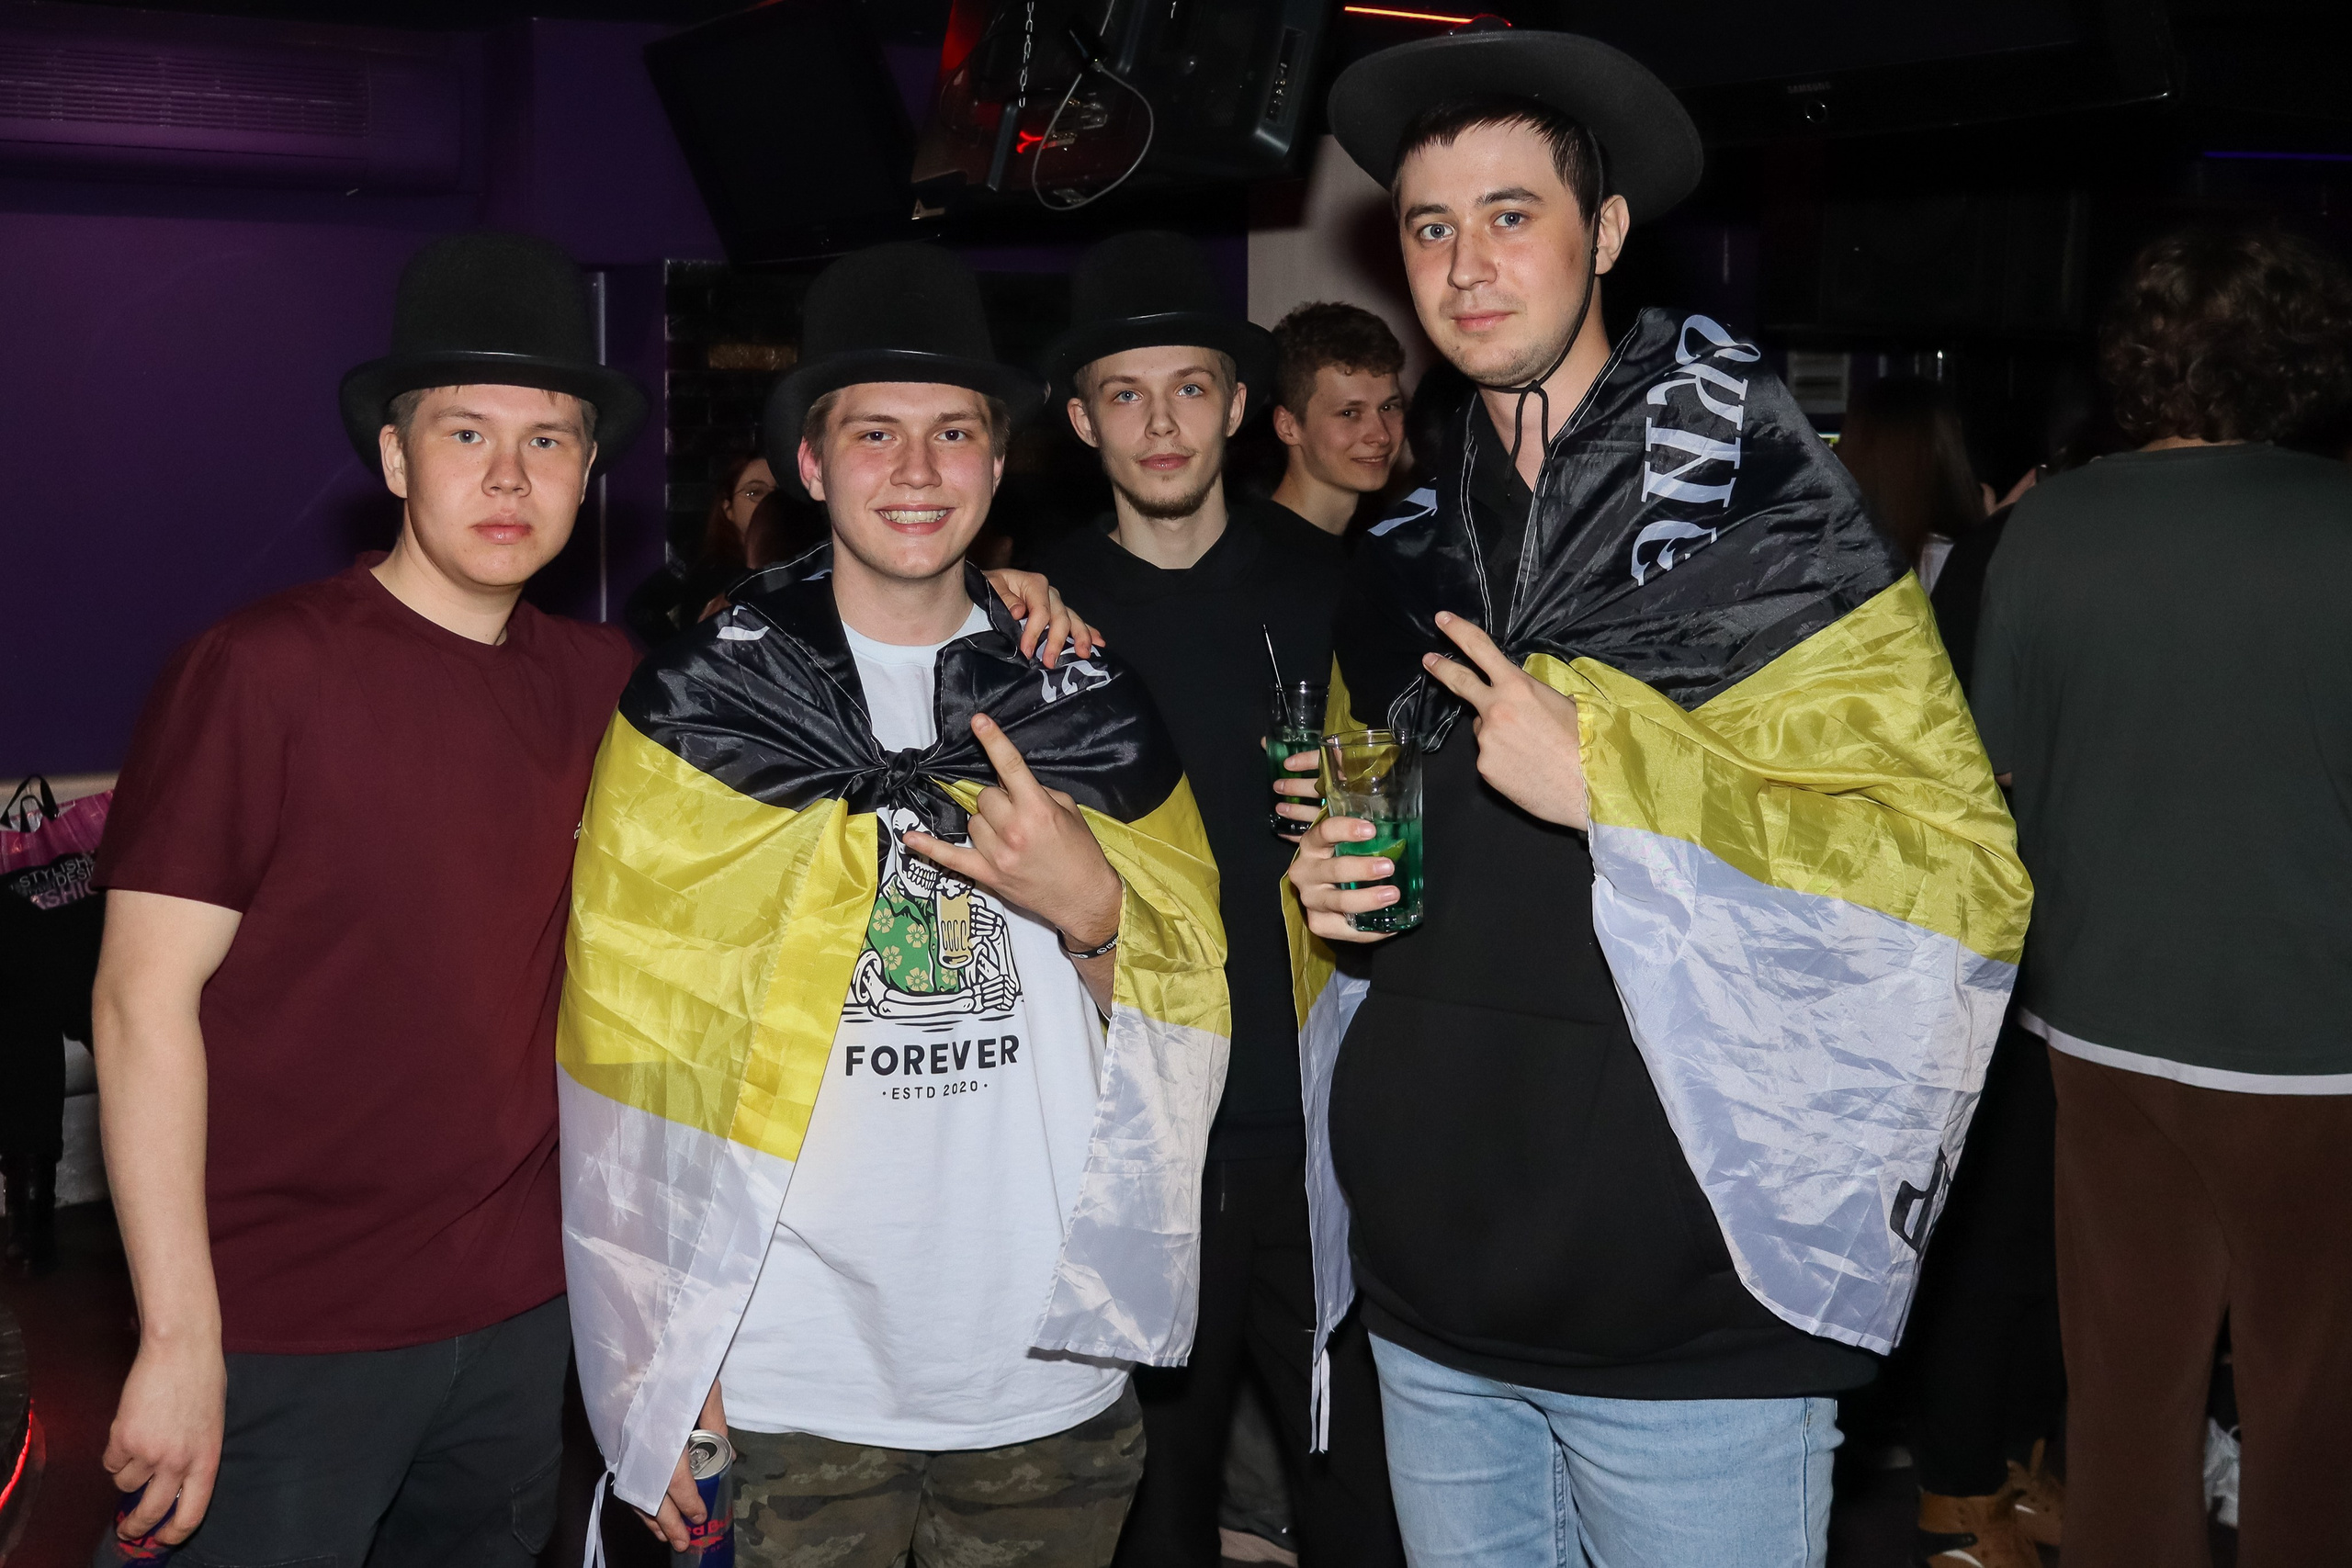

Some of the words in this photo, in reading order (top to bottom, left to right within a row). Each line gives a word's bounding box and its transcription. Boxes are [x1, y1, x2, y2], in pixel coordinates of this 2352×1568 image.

[54, 863, 95, 887] DESI
[845, 1034, 1020, 1076] FOREVER
[891, 1085, 935, 1100] ESTD
[943, 1080, 978, 1097] 2020
